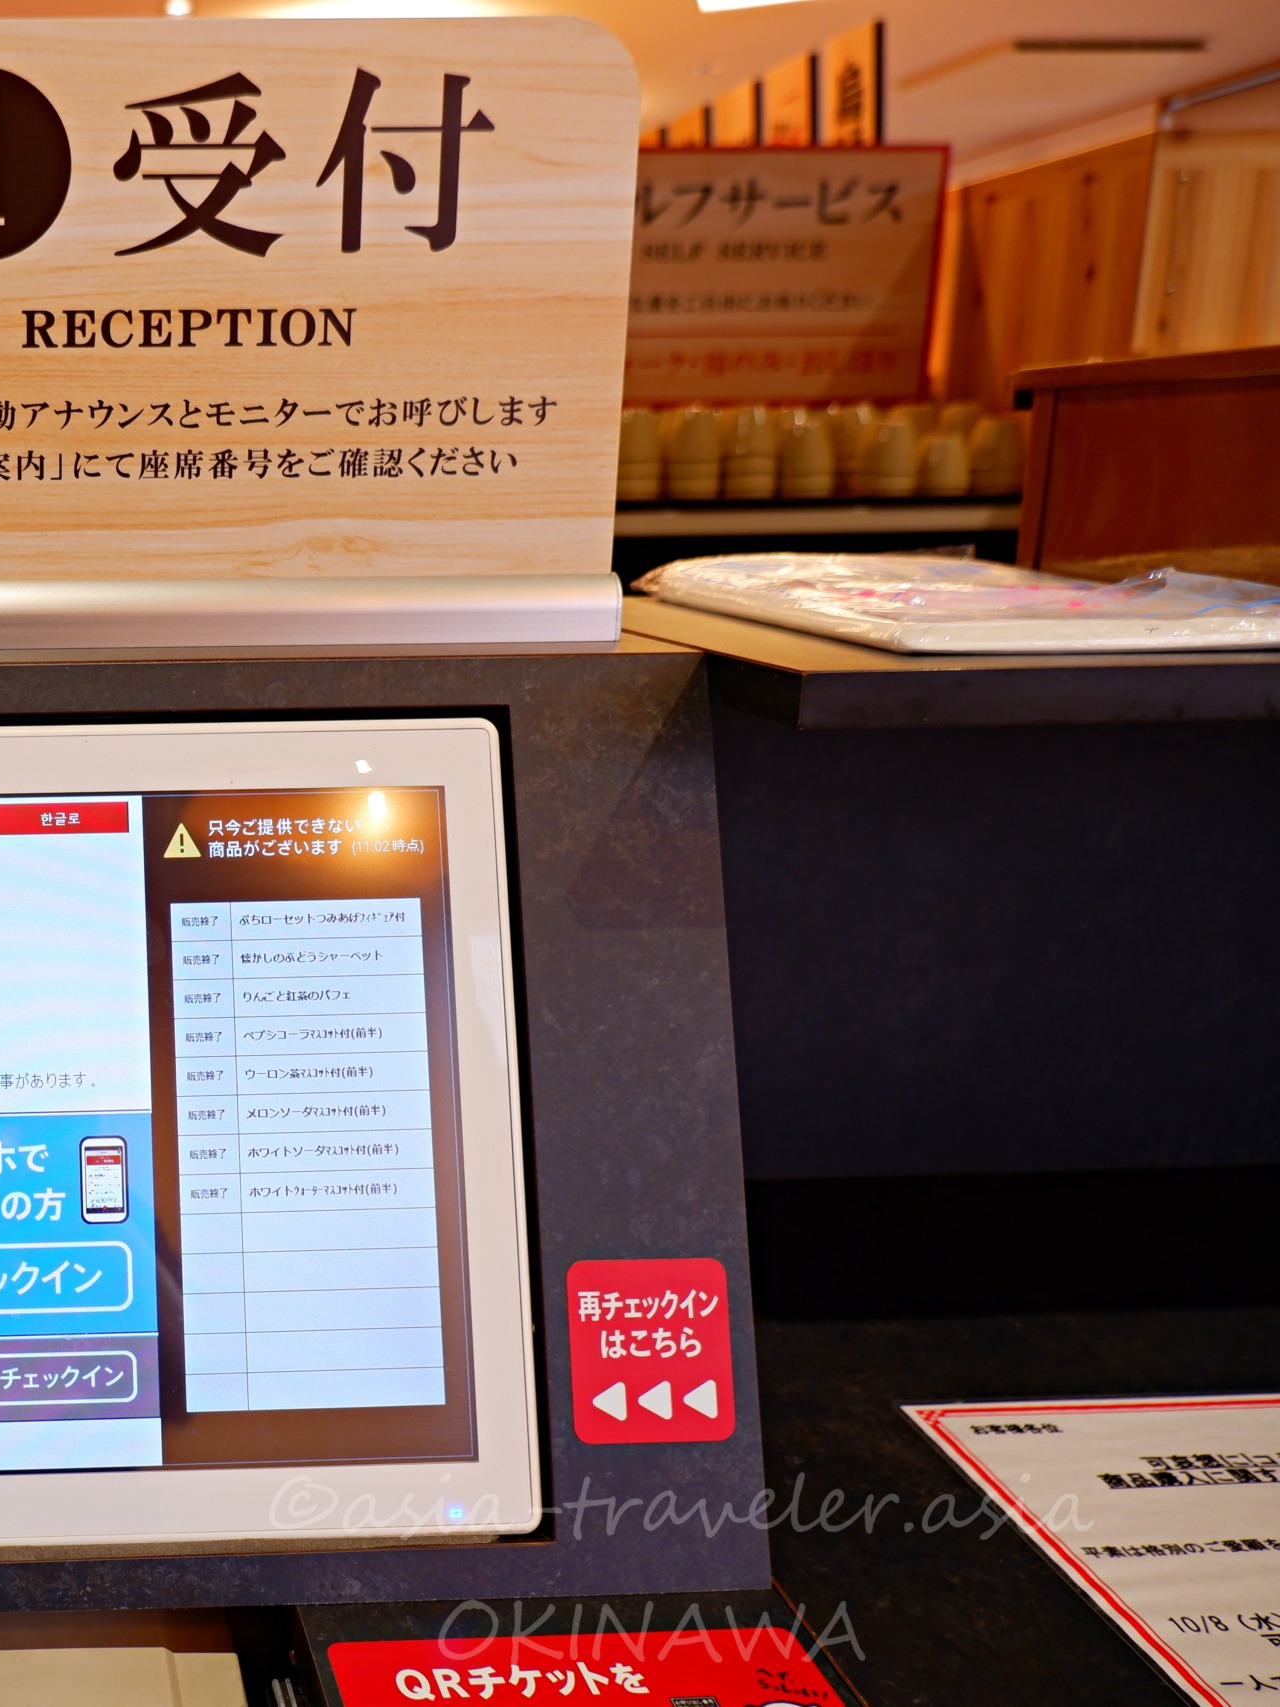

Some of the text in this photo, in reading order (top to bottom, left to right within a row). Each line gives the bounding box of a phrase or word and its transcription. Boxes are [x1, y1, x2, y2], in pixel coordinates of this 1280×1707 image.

[113, 68, 494, 257] 受付
[22, 309, 356, 348] RECEPTION
[41, 813, 80, 826] 한글로
[208, 818, 361, 837] 只今ご提供できない
[208, 839, 342, 858] 商品がございます
[181, 916, 218, 927] 販売終了
[182, 954, 220, 966] 販売終了
[184, 989, 352, 1004] 販売終了 りんごと紅茶のパフェ
[185, 1031, 222, 1043] 販売終了
[186, 1070, 224, 1082] 販売終了
[188, 1109, 225, 1121] 販売終了
[189, 1149, 227, 1160] 販売終了
[190, 1188, 228, 1199] 販売終了
[578, 1290, 718, 1321] 再チェックイン
[601, 1327, 701, 1358] はこちら
[1167, 1614, 1230, 1635] 10/8
[395, 1658, 651, 1703] QRチケットを
